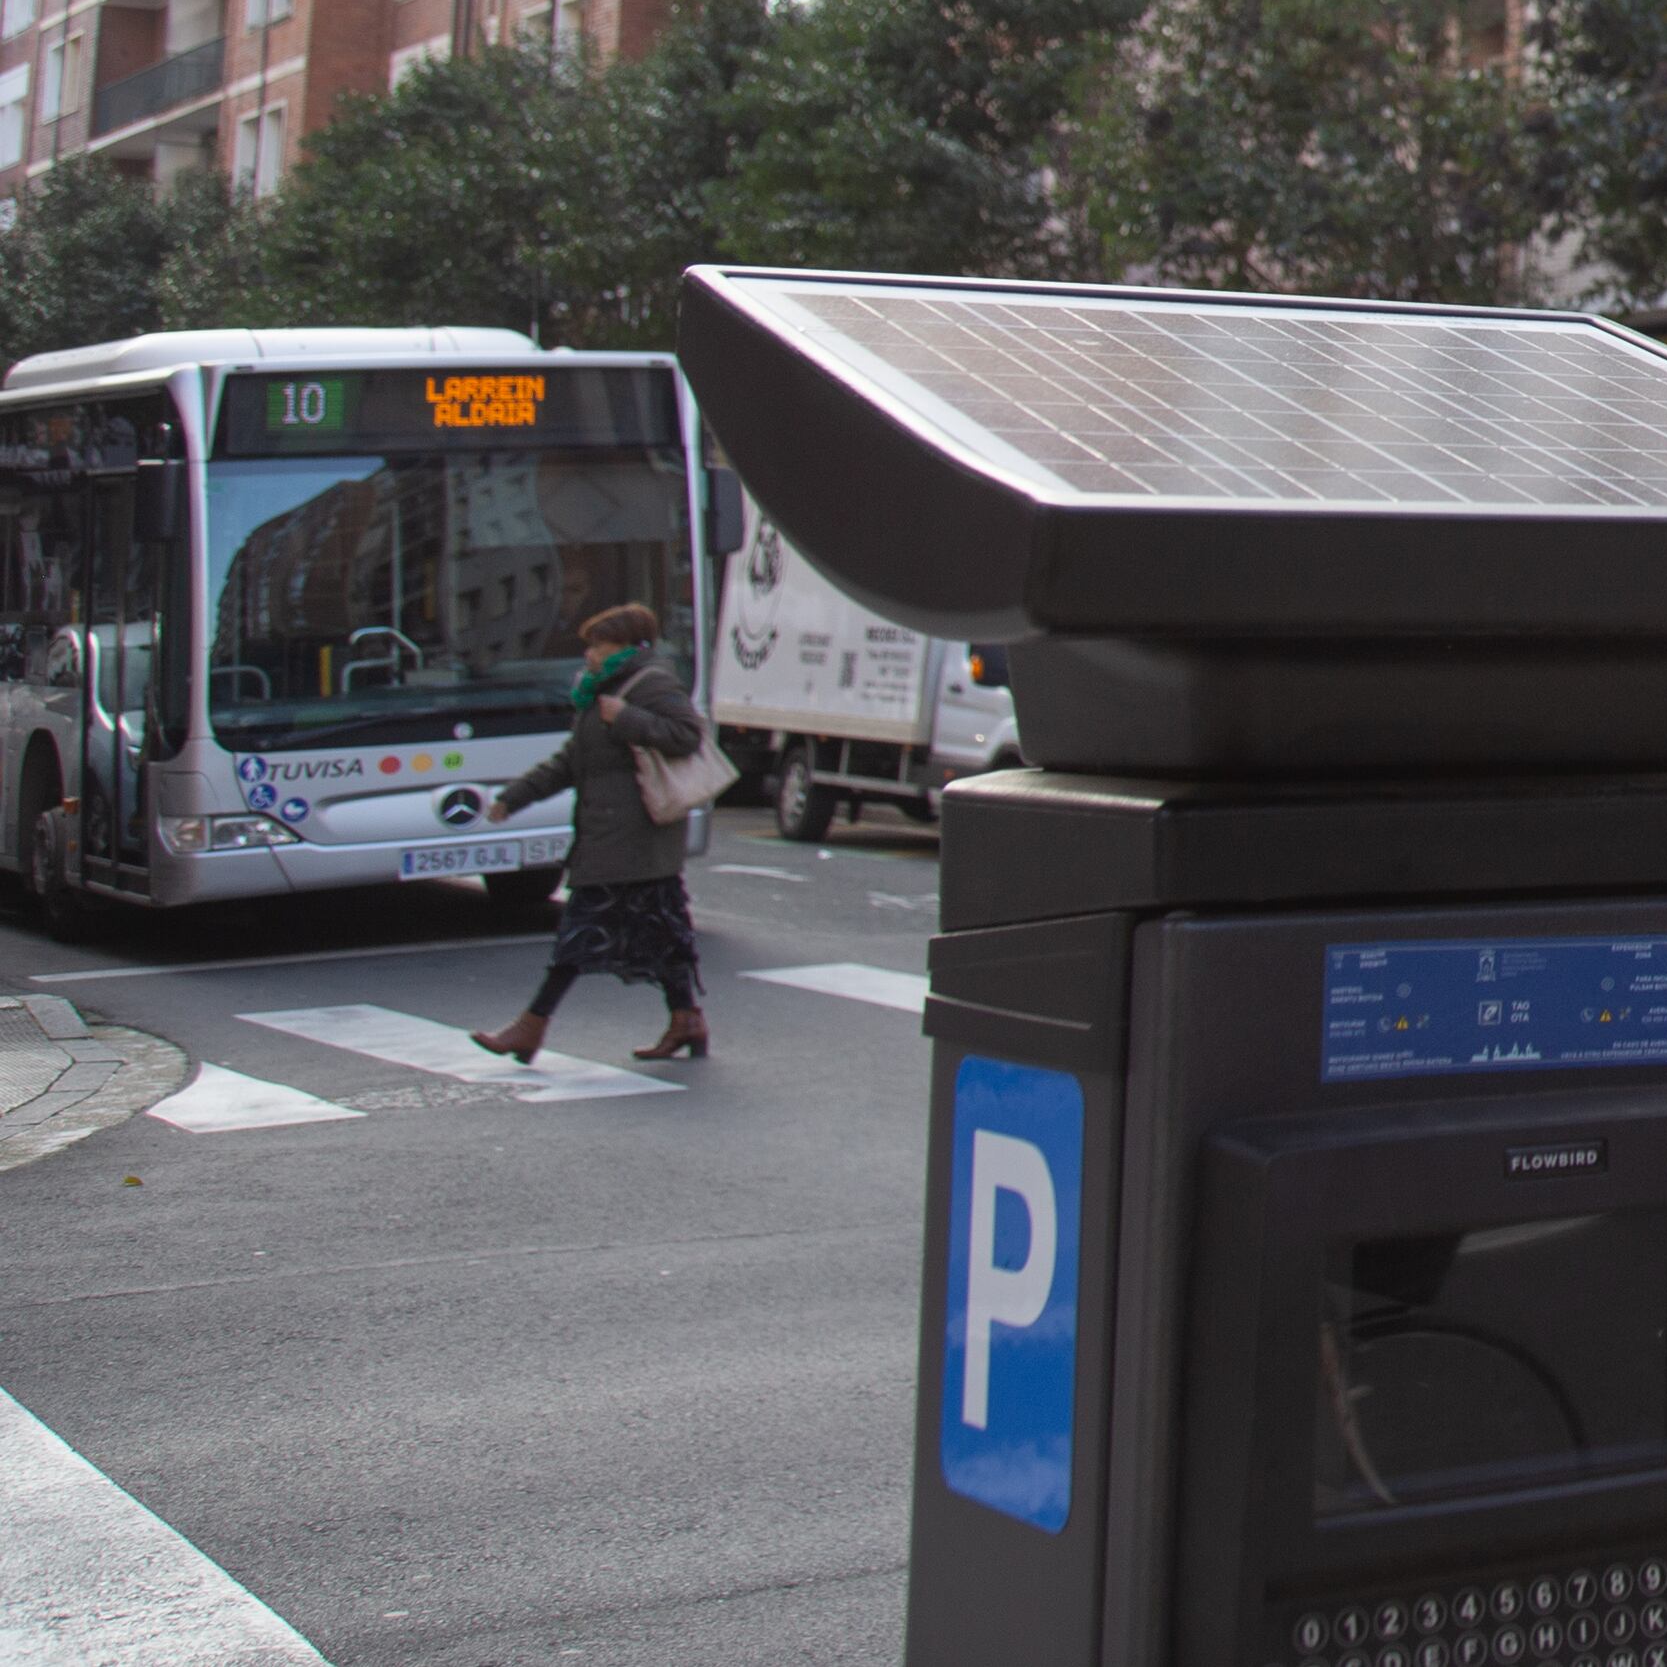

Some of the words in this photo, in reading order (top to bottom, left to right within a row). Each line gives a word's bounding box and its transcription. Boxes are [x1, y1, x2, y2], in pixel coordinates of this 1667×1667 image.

[425, 376, 545, 403] LARREIN
[282, 382, 327, 424] 10
[267, 757, 364, 782] TUVISA
[416, 847, 469, 872] 2567
[1511, 1001, 1530, 1012] TAO
[1511, 1012, 1530, 1023] OTA
[1511, 1149, 1598, 1172] FLOWBIRD
[962, 1128, 1058, 1431] P
[1303, 1619, 1320, 1648] 0
[1345, 1612, 1357, 1642] 1
[1383, 1606, 1399, 1635] 2
[1423, 1599, 1439, 1628] 3
[1460, 1593, 1478, 1621] 4
[1500, 1587, 1516, 1615] 5
[1537, 1582, 1552, 1609] 6
[1574, 1576, 1588, 1603] 7
[1610, 1569, 1625, 1596] 8
[1646, 1564, 1661, 1591] 9
[1464, 1638, 1478, 1664] F
[1500, 1632, 1518, 1656] G
[1538, 1626, 1554, 1650] H
[1614, 1614, 1626, 1637] J
[1649, 1608, 1664, 1630] K
